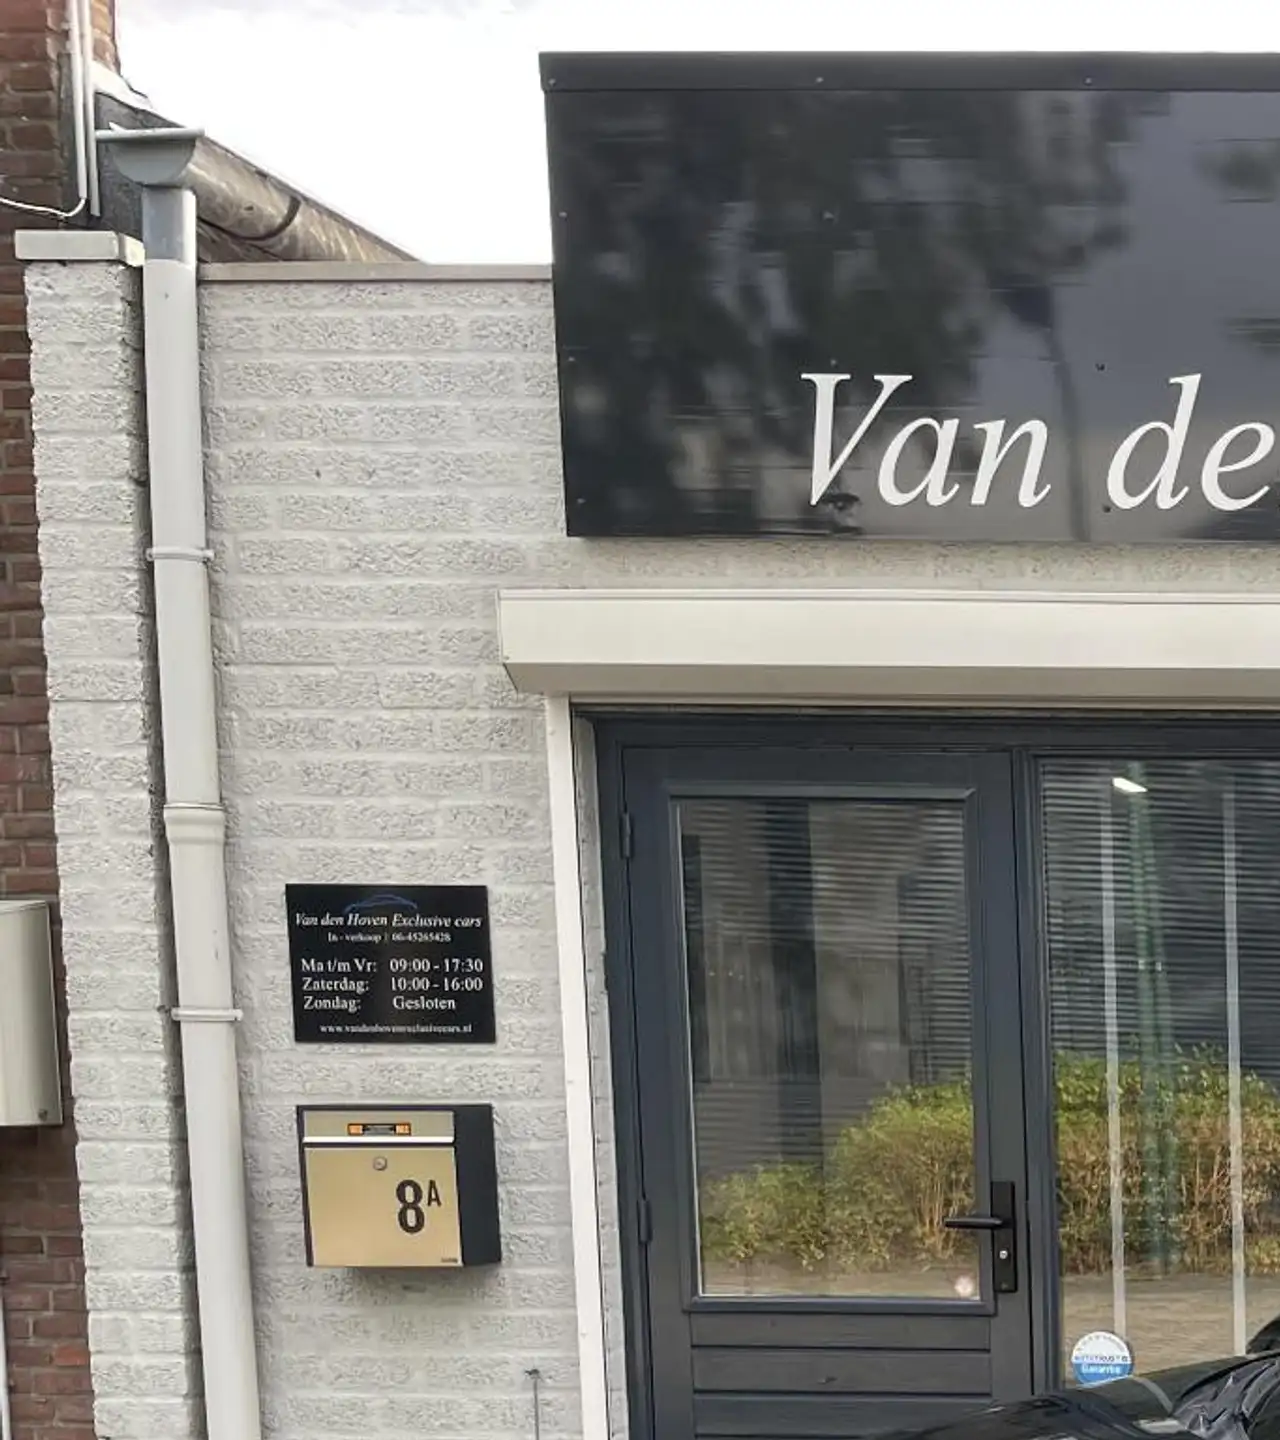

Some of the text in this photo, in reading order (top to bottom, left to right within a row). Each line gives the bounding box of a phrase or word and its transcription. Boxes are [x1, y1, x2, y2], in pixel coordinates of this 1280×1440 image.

[800, 372, 1052, 509] Van
[296, 913, 482, 928] Van den Hoven Exclusive cars
[301, 958, 323, 972] Ma
[326, 957, 351, 972] t/m
[353, 959, 377, 973] Vr:
[389, 958, 430, 973] 09:00
[443, 958, 483, 973] 17:30
[302, 977, 369, 994] Zaterdag:
[391, 977, 430, 992] 10:00
[443, 977, 483, 992] 16:00
[304, 996, 456, 1012] Zondag: Gesloten
